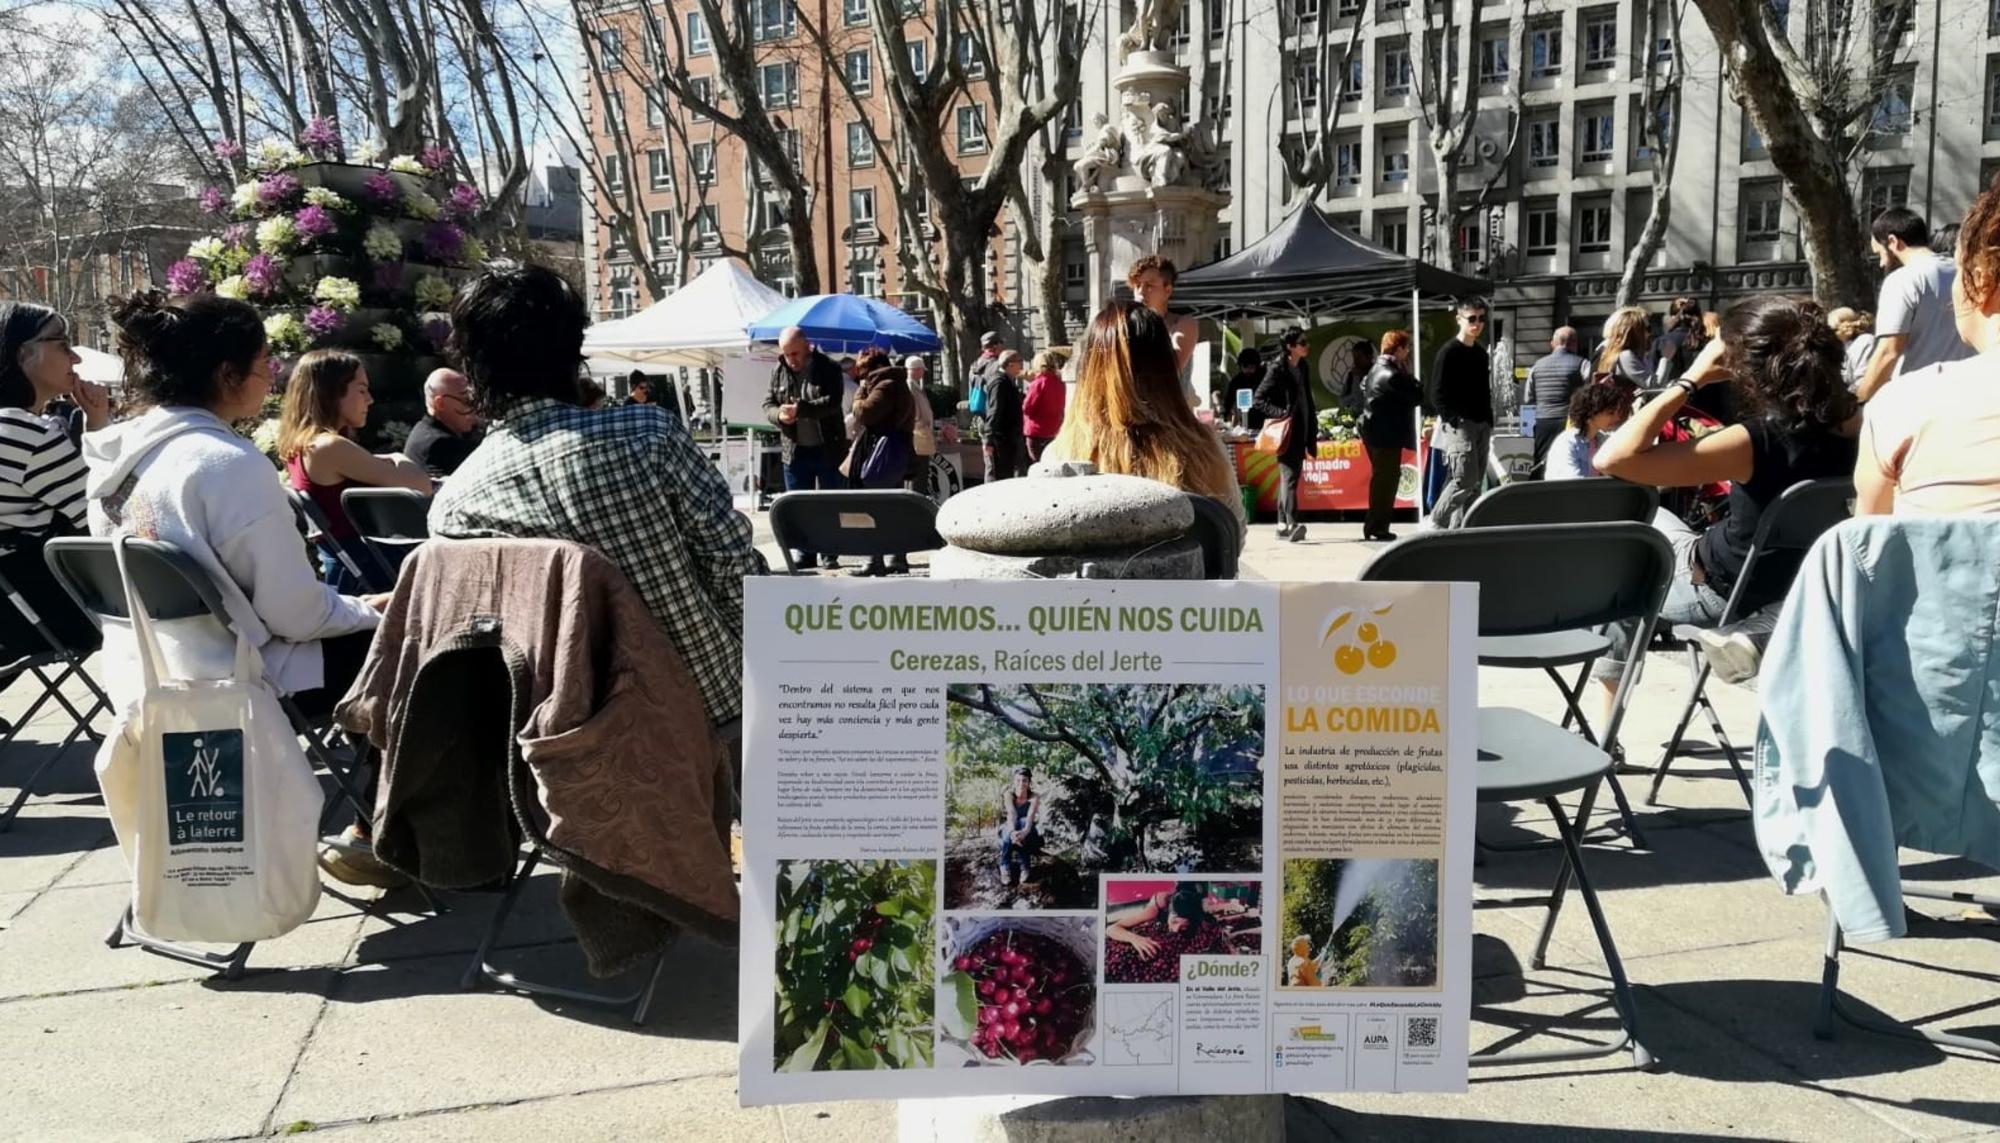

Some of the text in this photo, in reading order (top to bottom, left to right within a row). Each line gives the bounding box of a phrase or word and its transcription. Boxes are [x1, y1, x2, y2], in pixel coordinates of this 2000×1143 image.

[1317, 442, 1361, 459] erta
[1303, 458, 1351, 471] la madre
[785, 597, 1264, 636] QUÉ COMEMOS... QUIÉN NOS CUIDA
[890, 649, 1162, 674] Cerezas, Raíces del Jerte
[820, 683, 833, 694] del
[842, 684, 873, 694] sistema
[901, 687, 916, 696] que
[1287, 686, 1441, 704] LO QUE ESCONDE
[779, 700, 831, 709] encontramos
[848, 699, 876, 709] resulta
[876, 698, 896, 712] fácil
[899, 702, 918, 712] pero
[919, 699, 939, 709] cada
[797, 713, 812, 727] hay
[816, 714, 834, 724] más
[838, 714, 881, 724] conciencia
[885, 717, 891, 727] y
[895, 715, 913, 724] más
[917, 715, 940, 727] gente
[1287, 707, 1441, 733] LA COMIDA
[1285, 744, 1442, 760] La industria de producción de frutas
[1304, 760, 1339, 770] distintos
[176, 809, 238, 824] Le retour
[177, 826, 187, 840] à
[1187, 959, 1260, 980] ¿Dónde?
[1364, 1035, 1389, 1044] AUPA
